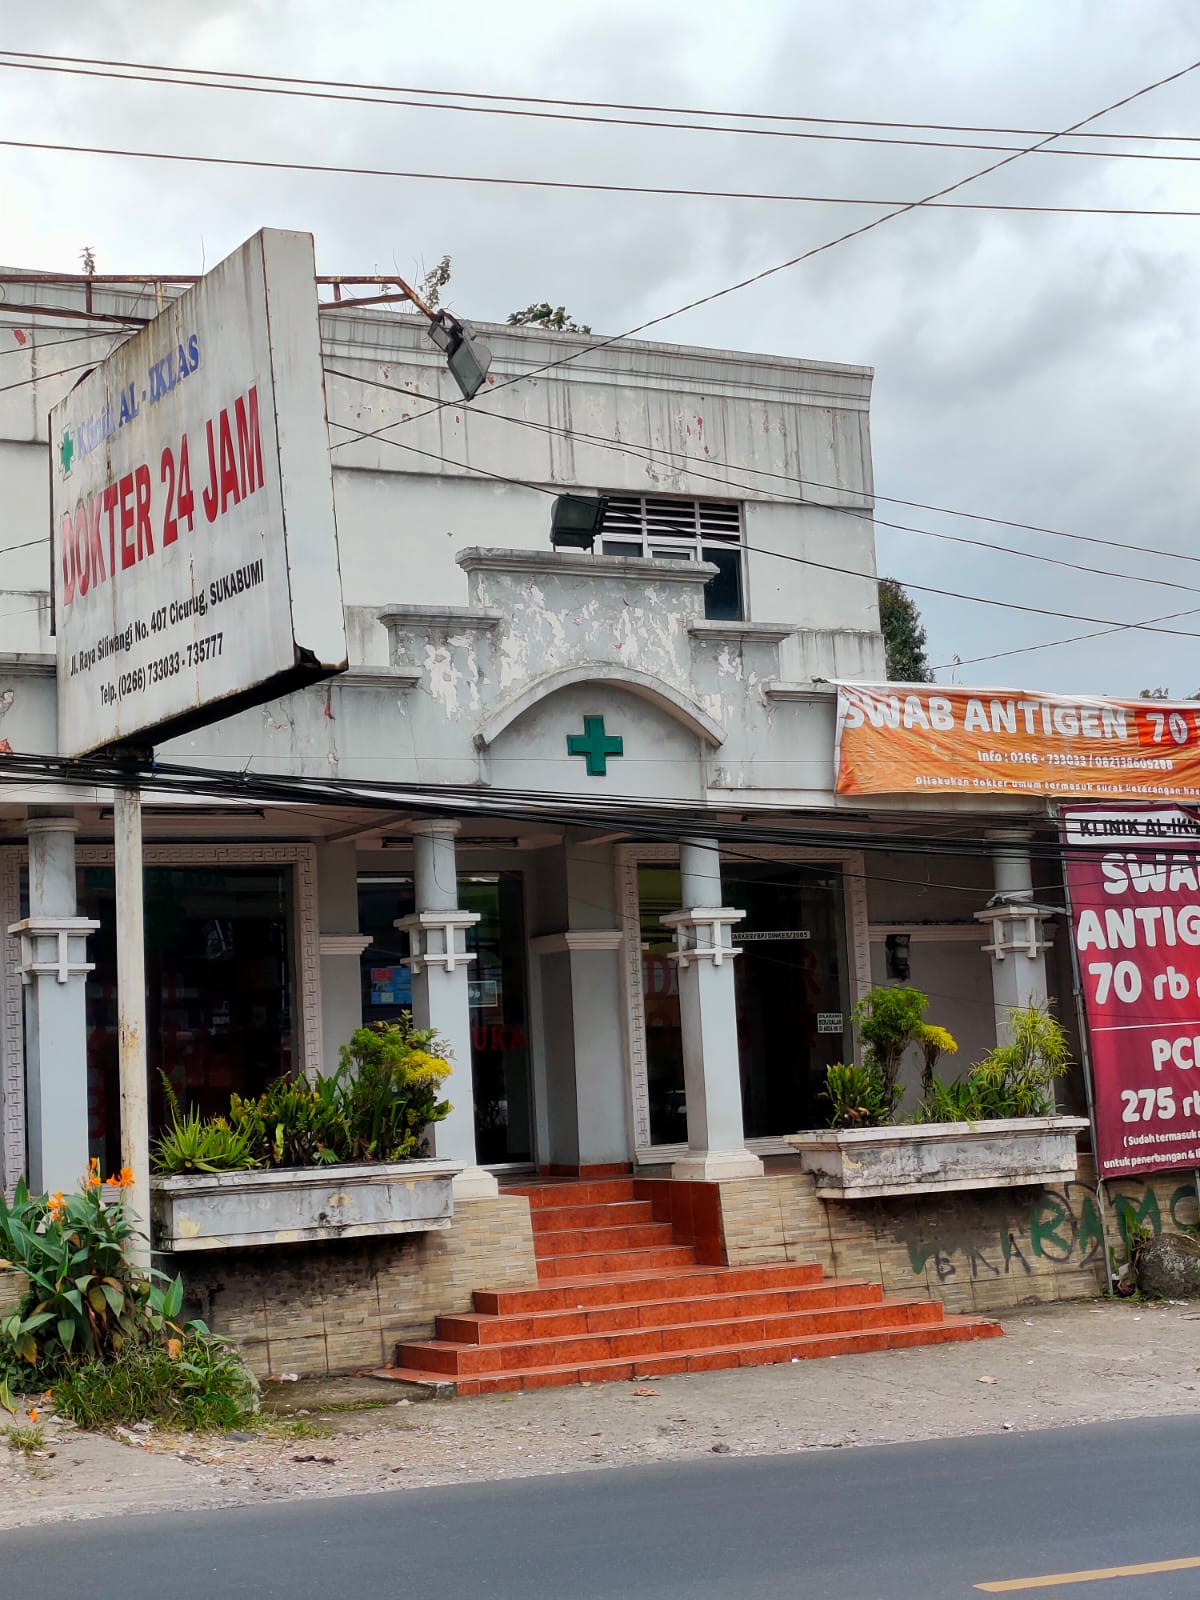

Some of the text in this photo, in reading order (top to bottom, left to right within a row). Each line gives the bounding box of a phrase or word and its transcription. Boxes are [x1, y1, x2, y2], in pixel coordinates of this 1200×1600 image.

[119, 382, 139, 428] AL
[148, 334, 199, 405] IKLAS
[61, 385, 265, 607] DOKTER 24 JAM
[80, 647, 96, 672] Raya
[97, 623, 133, 660] Siliwangi
[134, 620, 149, 643] No.
[151, 607, 167, 633] 407
[169, 590, 208, 625] Cicurug,
[210, 558, 264, 605] SUKABUMI
[100, 681, 117, 706] Telp.
[118, 667, 146, 701] (0266)
[147, 651, 180, 685] 733033
[186, 632, 223, 668] 735777
[843, 694, 955, 731] SWAB
[964, 699, 1128, 740] ANTIGEN
[1146, 712, 1188, 744] 70
[977, 750, 1002, 762] Info
[1010, 752, 1038, 764] 0266
[973, 777, 1008, 788] dokter
[1045, 781, 1093, 792] termasuk
[1080, 819, 1139, 837] KLINIK
[1101, 853, 1200, 894] SWA
[1088, 960, 1143, 1004] 70
[1153, 966, 1190, 1001] rb
[1120, 1086, 1176, 1123] 275
[1156, 1130, 1197, 1142] termasuk
[1103, 1157, 1131, 1169] untuk
[1131, 1152, 1188, 1168] penerbangan
